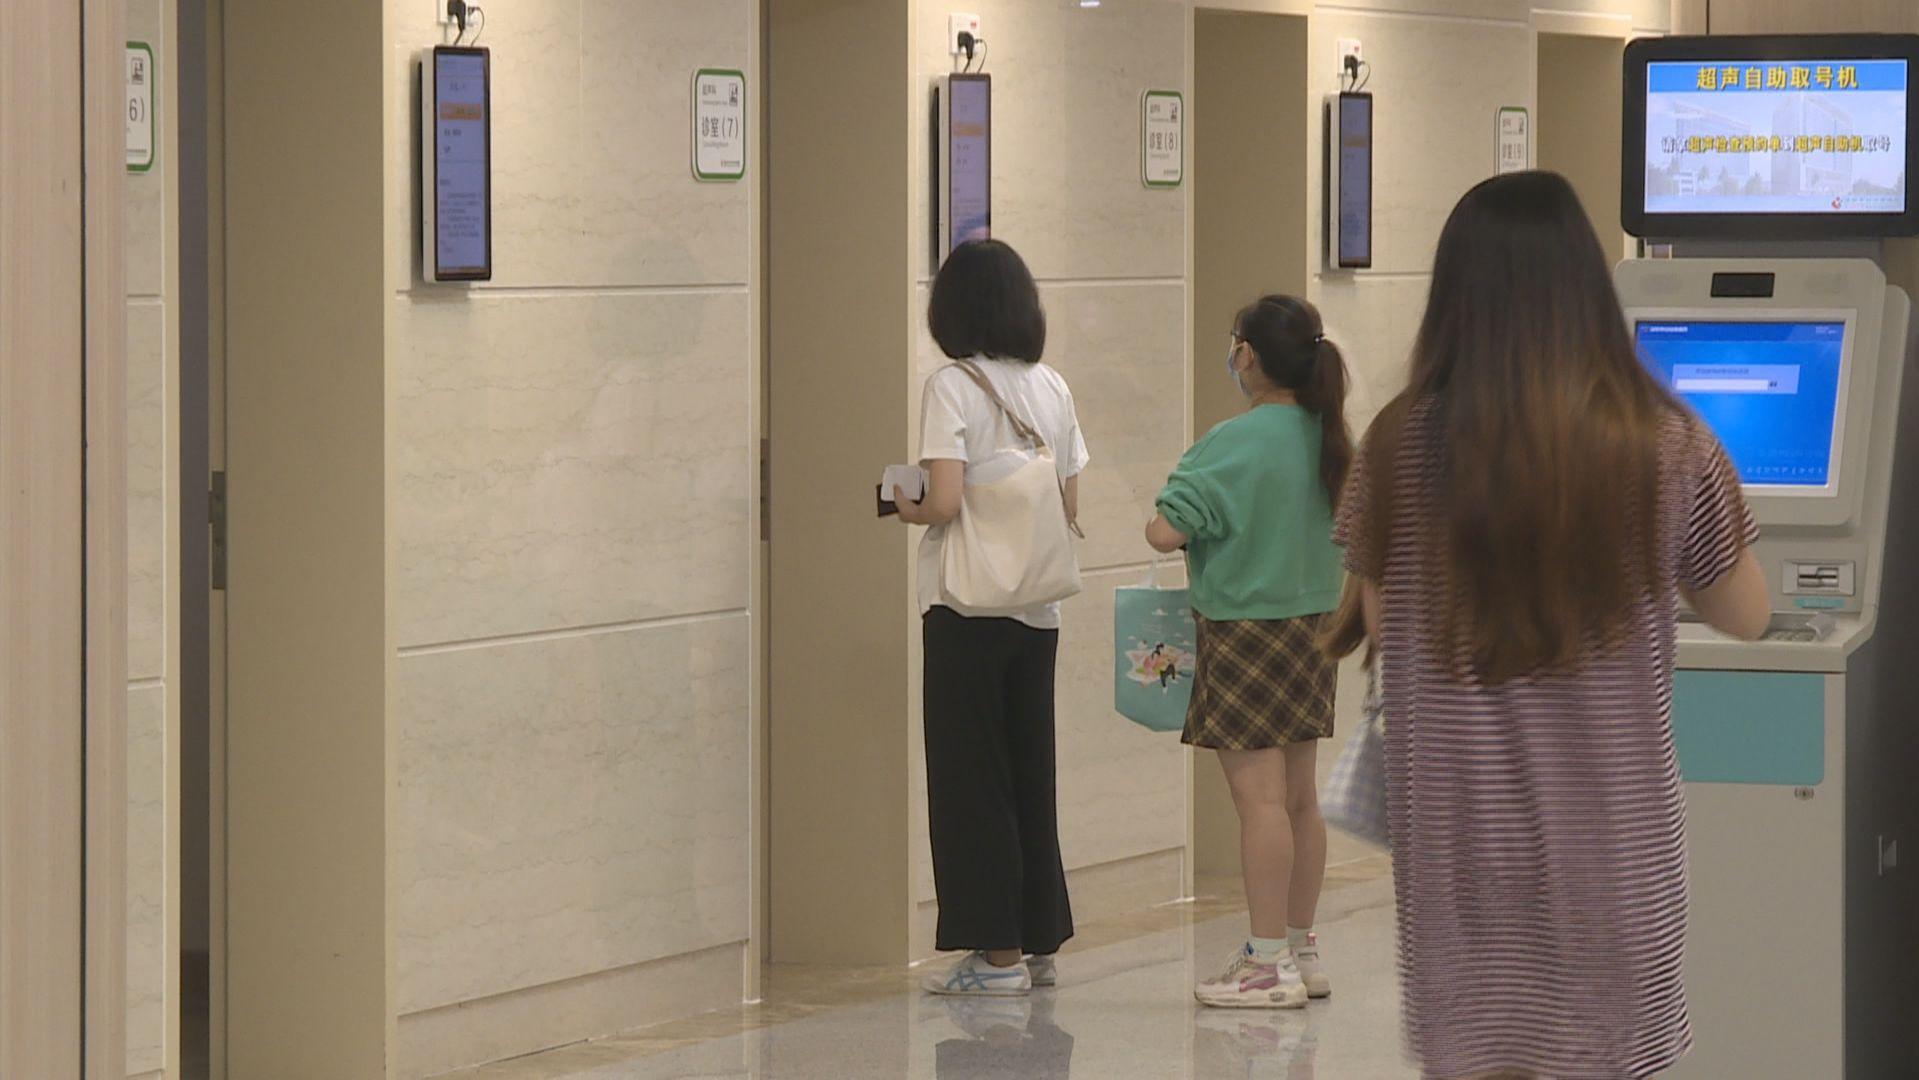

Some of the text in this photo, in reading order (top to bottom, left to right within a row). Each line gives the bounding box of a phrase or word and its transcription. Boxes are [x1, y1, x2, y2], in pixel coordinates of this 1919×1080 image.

[1696, 65, 1859, 90] 超声自助取号机
